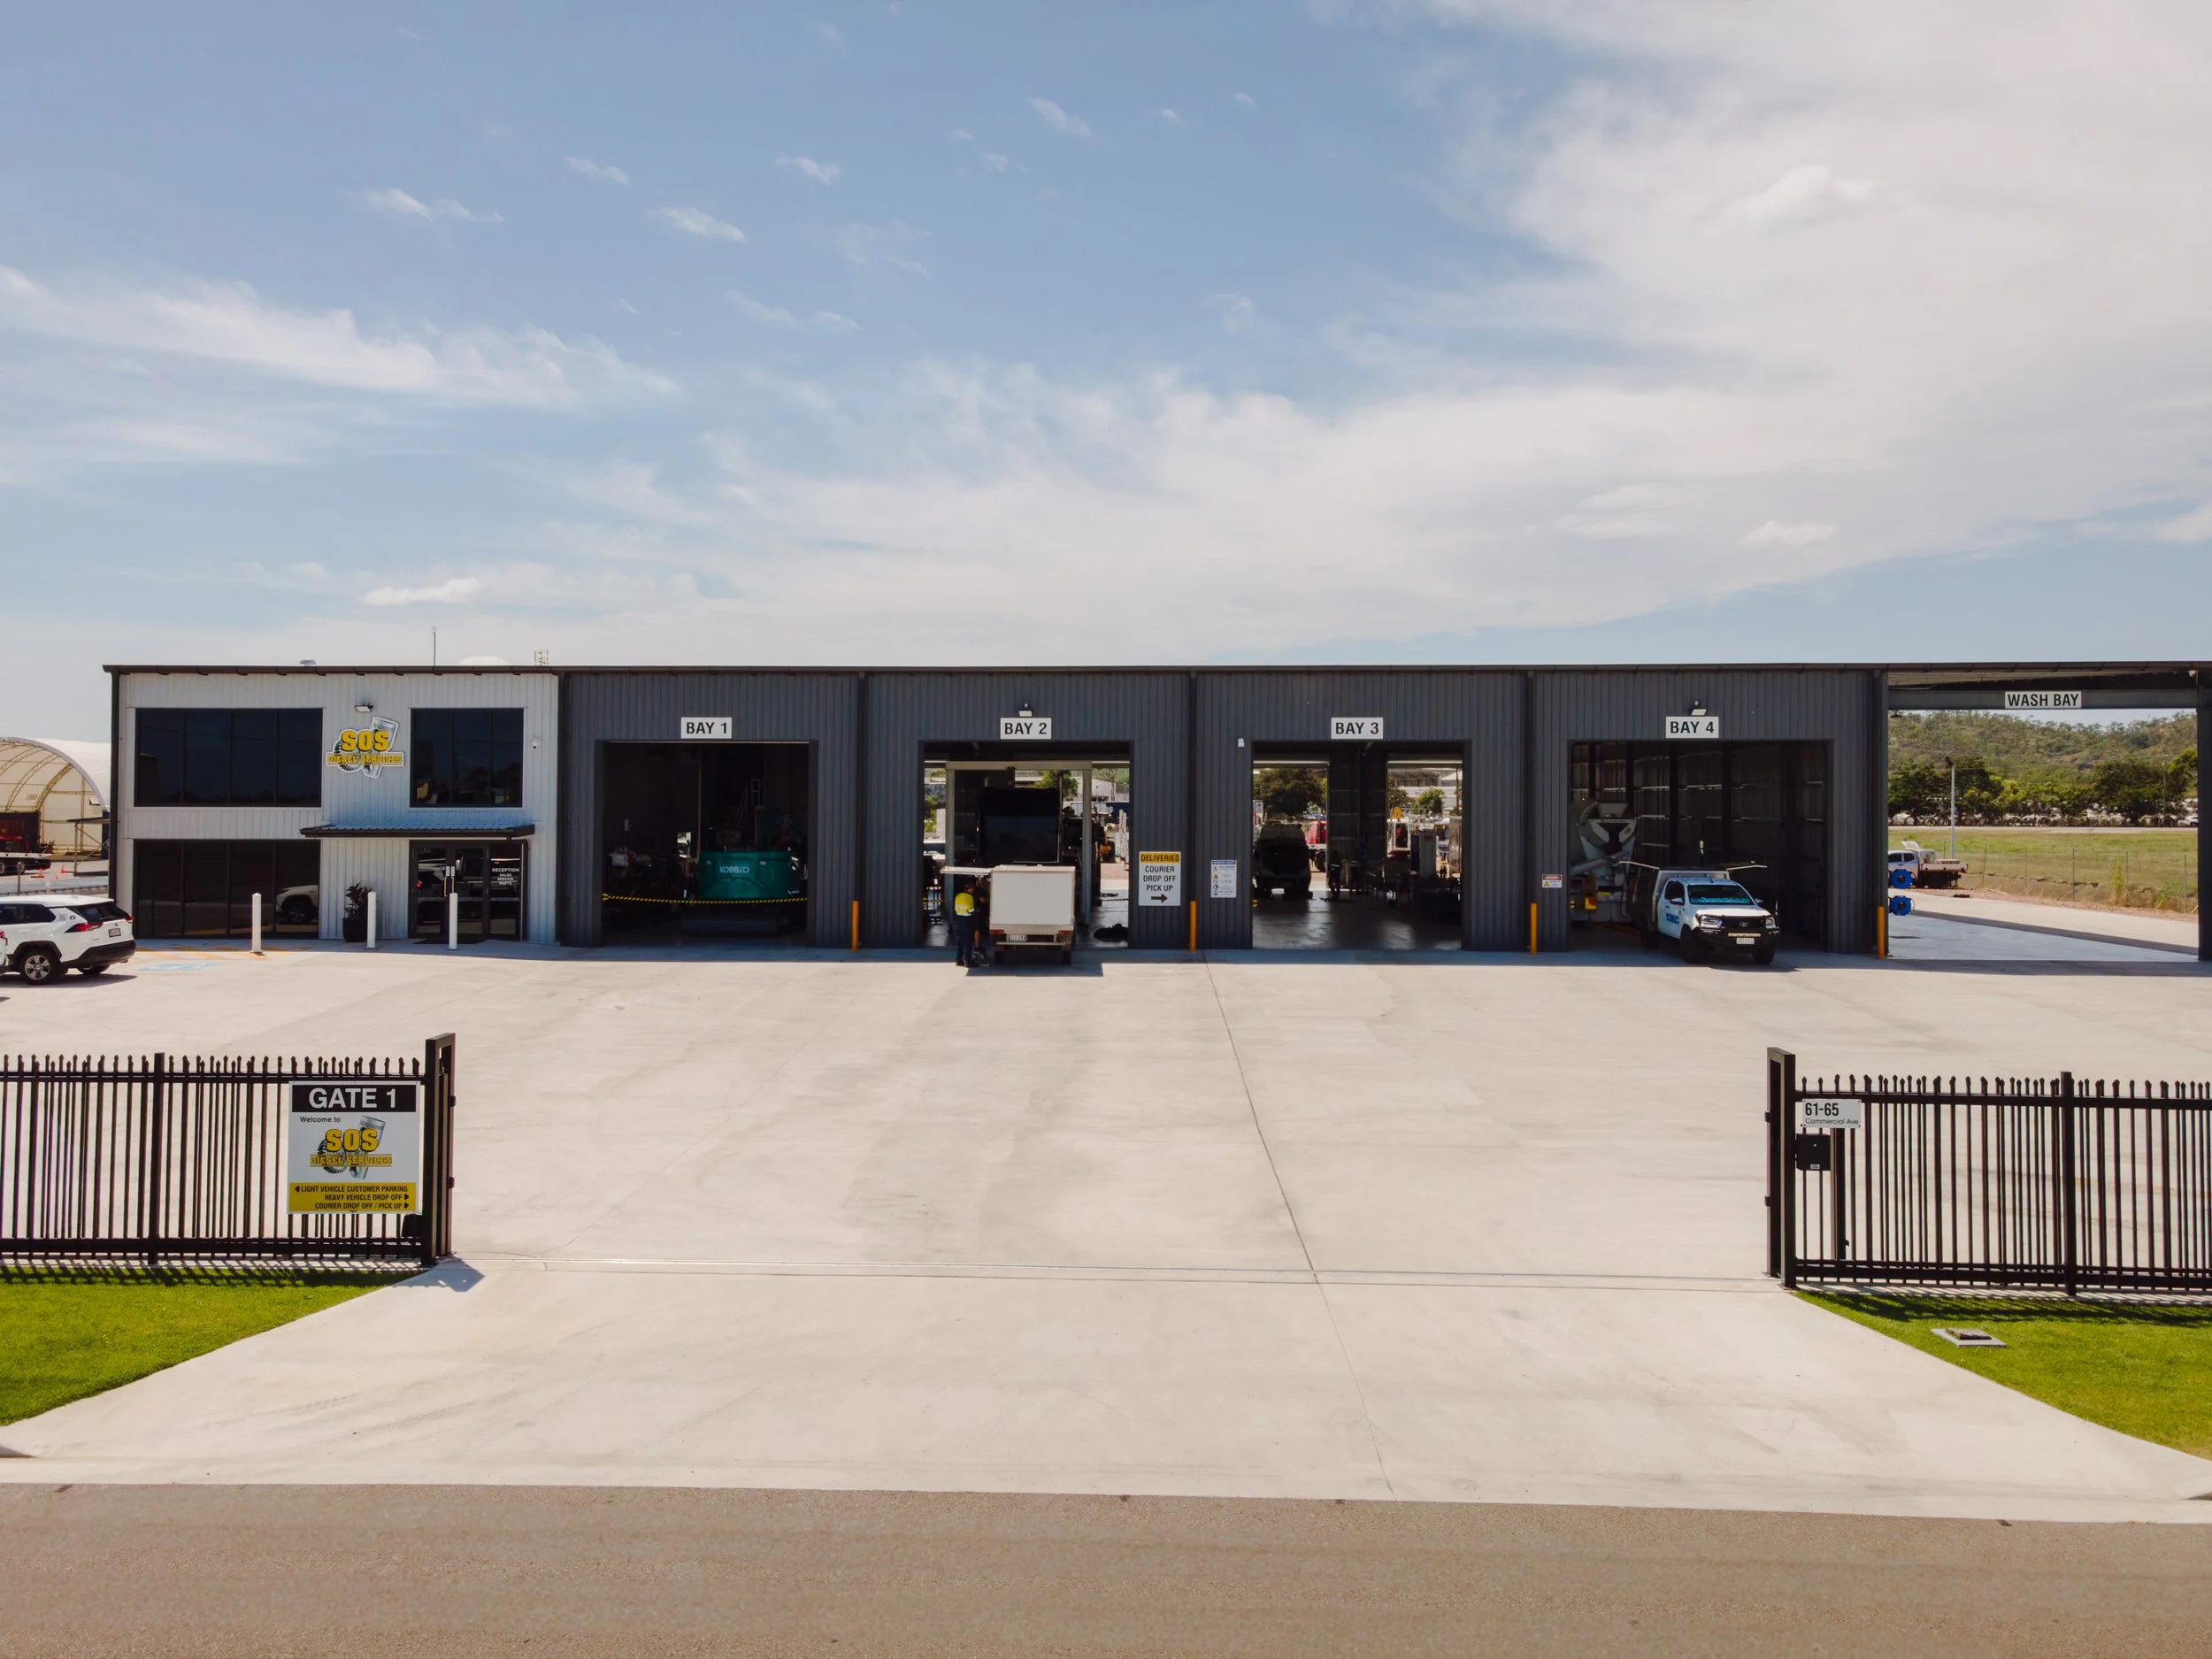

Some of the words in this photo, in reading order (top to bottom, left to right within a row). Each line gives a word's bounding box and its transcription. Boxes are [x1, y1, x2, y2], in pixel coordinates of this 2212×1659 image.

[2008, 694, 2048, 707] WASH
[2054, 694, 2079, 707] BAY
[686, 721, 715, 734] BAY
[720, 721, 727, 734] 1
[1004, 722, 1033, 735] BAY
[1038, 722, 1048, 735] 2
[1335, 722, 1365, 735] BAY
[1370, 722, 1379, 735] 3
[1670, 721, 1700, 733] BAY
[1705, 721, 1715, 733] 4
[341, 730, 390, 752] SOS
[328, 754, 359, 764] DIESEL
[360, 754, 403, 764] SERVICES
[309, 1087, 378, 1109] GATE
[386, 1088, 396, 1109] 1
[1805, 1102, 1839, 1117] 61-65
[325, 1128, 380, 1152] SOS
[310, 1155, 344, 1165] DIESEL
[346, 1155, 392, 1165] SERVICES
